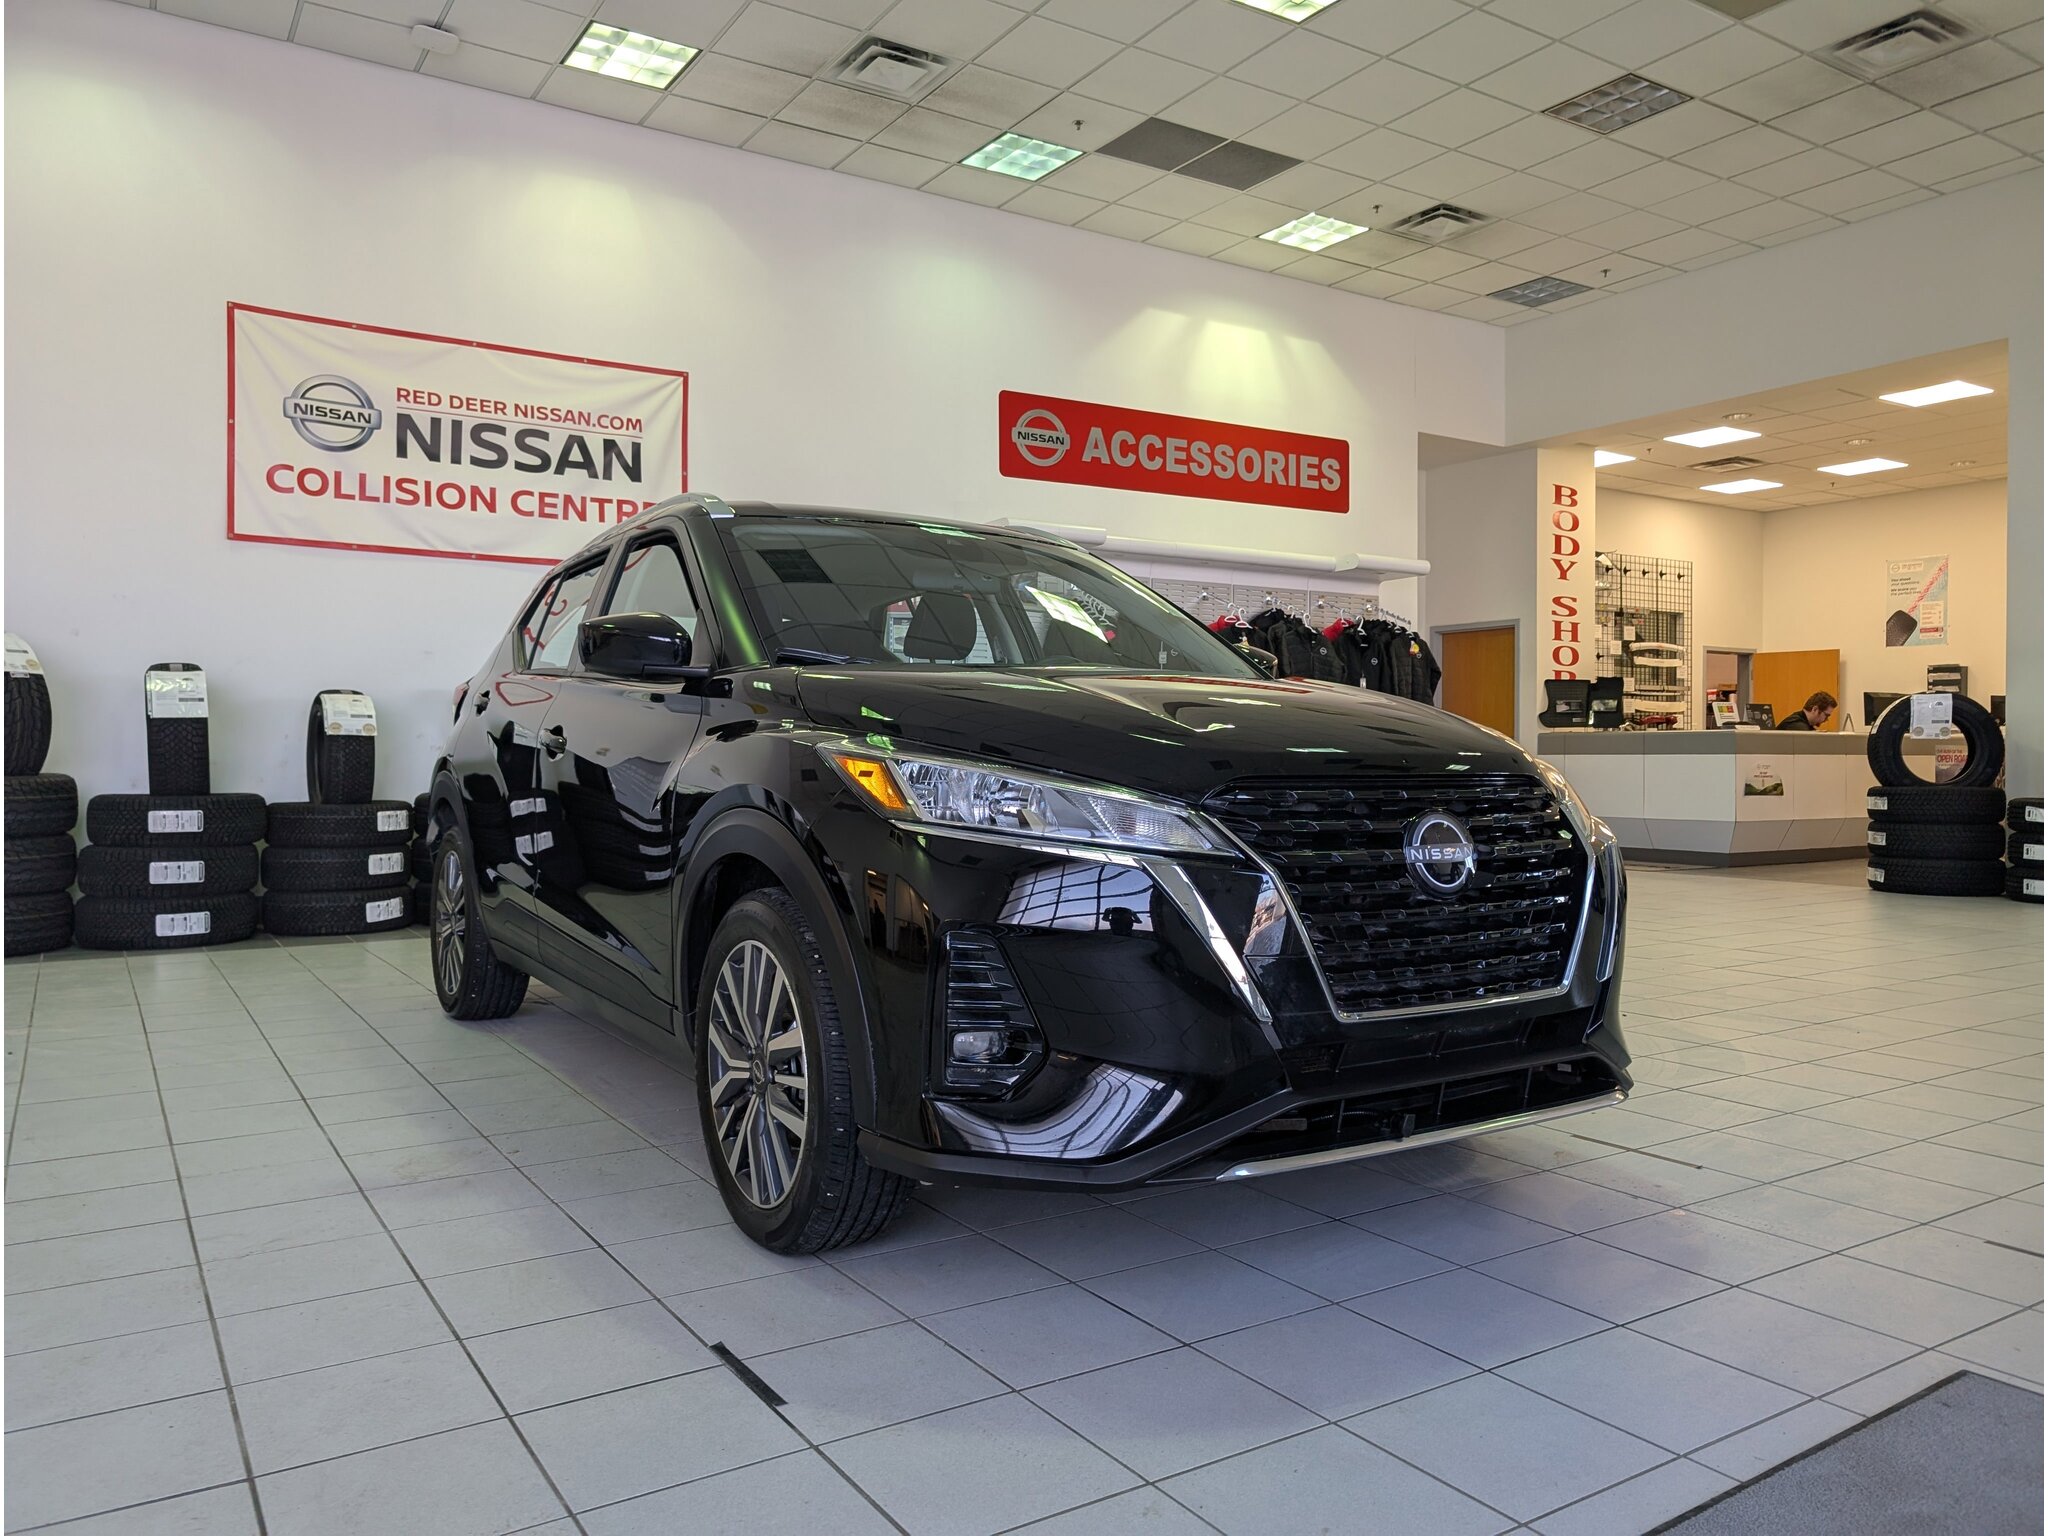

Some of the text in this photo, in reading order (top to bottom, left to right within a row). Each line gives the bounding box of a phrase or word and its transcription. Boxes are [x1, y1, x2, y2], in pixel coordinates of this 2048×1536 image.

[292, 402, 372, 425] NISSAN
[396, 386, 643, 434] RED DEER NISSAN.COM
[395, 412, 643, 484] NISSAN
[1016, 430, 1066, 447] NISSAN
[1081, 426, 1342, 492] ACCESSORIES
[264, 463, 657, 525] COLLISION CENTR
[1550, 483, 1581, 582] BODY
[1954, 753, 1968, 764] ROA
[1410, 846, 1473, 861] NISSAN
